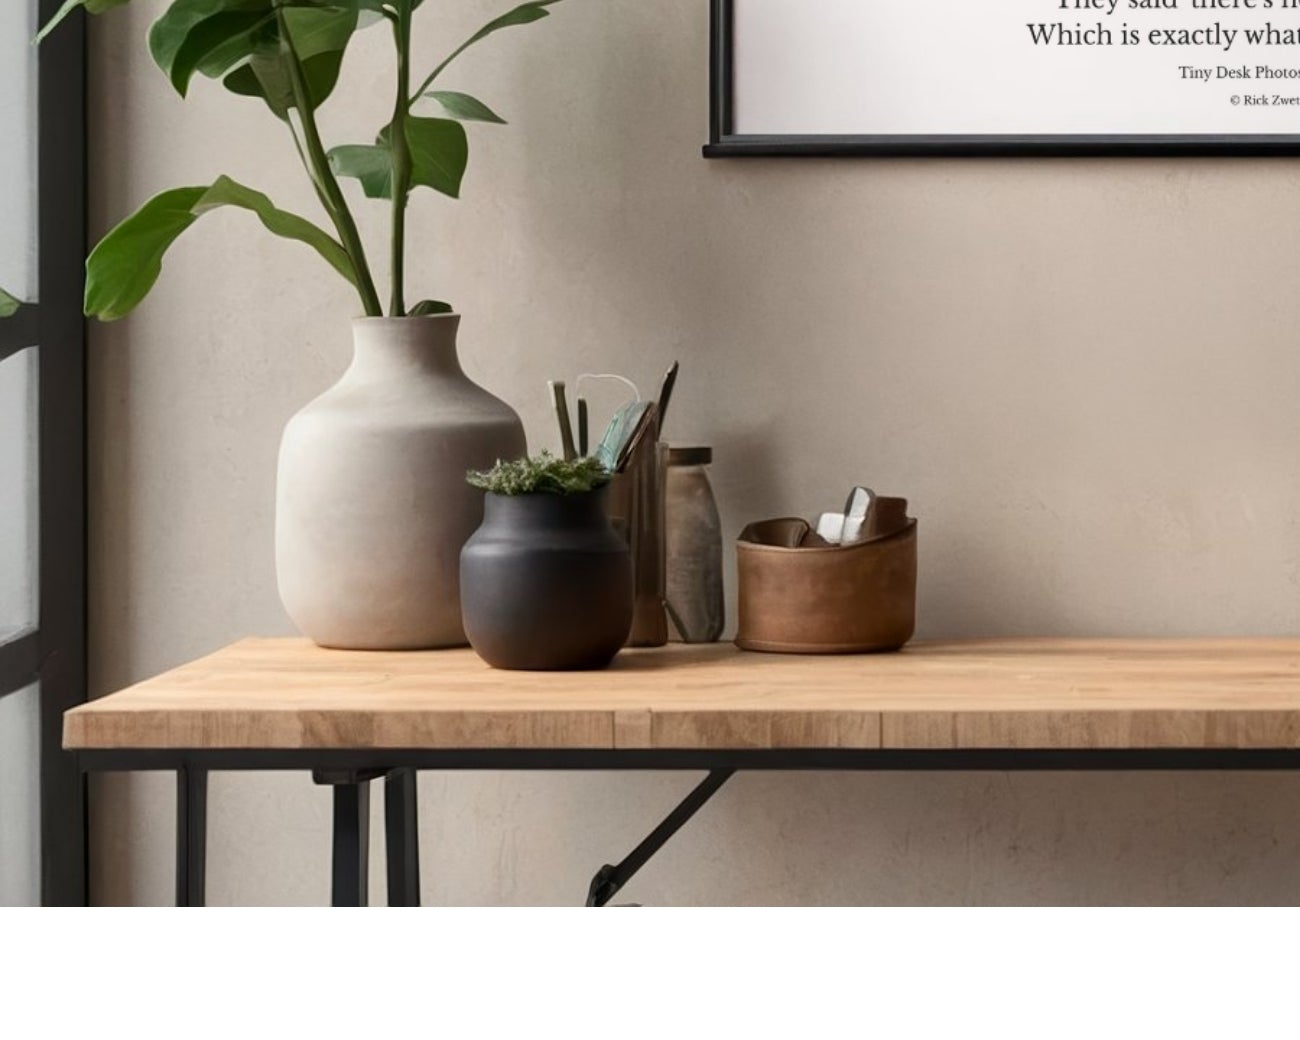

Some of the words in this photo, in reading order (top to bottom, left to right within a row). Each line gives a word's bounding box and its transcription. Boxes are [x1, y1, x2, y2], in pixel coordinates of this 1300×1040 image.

[1025, 22, 1113, 45] Which
[1120, 23, 1141, 45] is
[1147, 22, 1239, 51] exactly
[1177, 66, 1213, 82] Tiny
[1215, 65, 1252, 78] Desk
[1243, 95, 1269, 105] Rick
